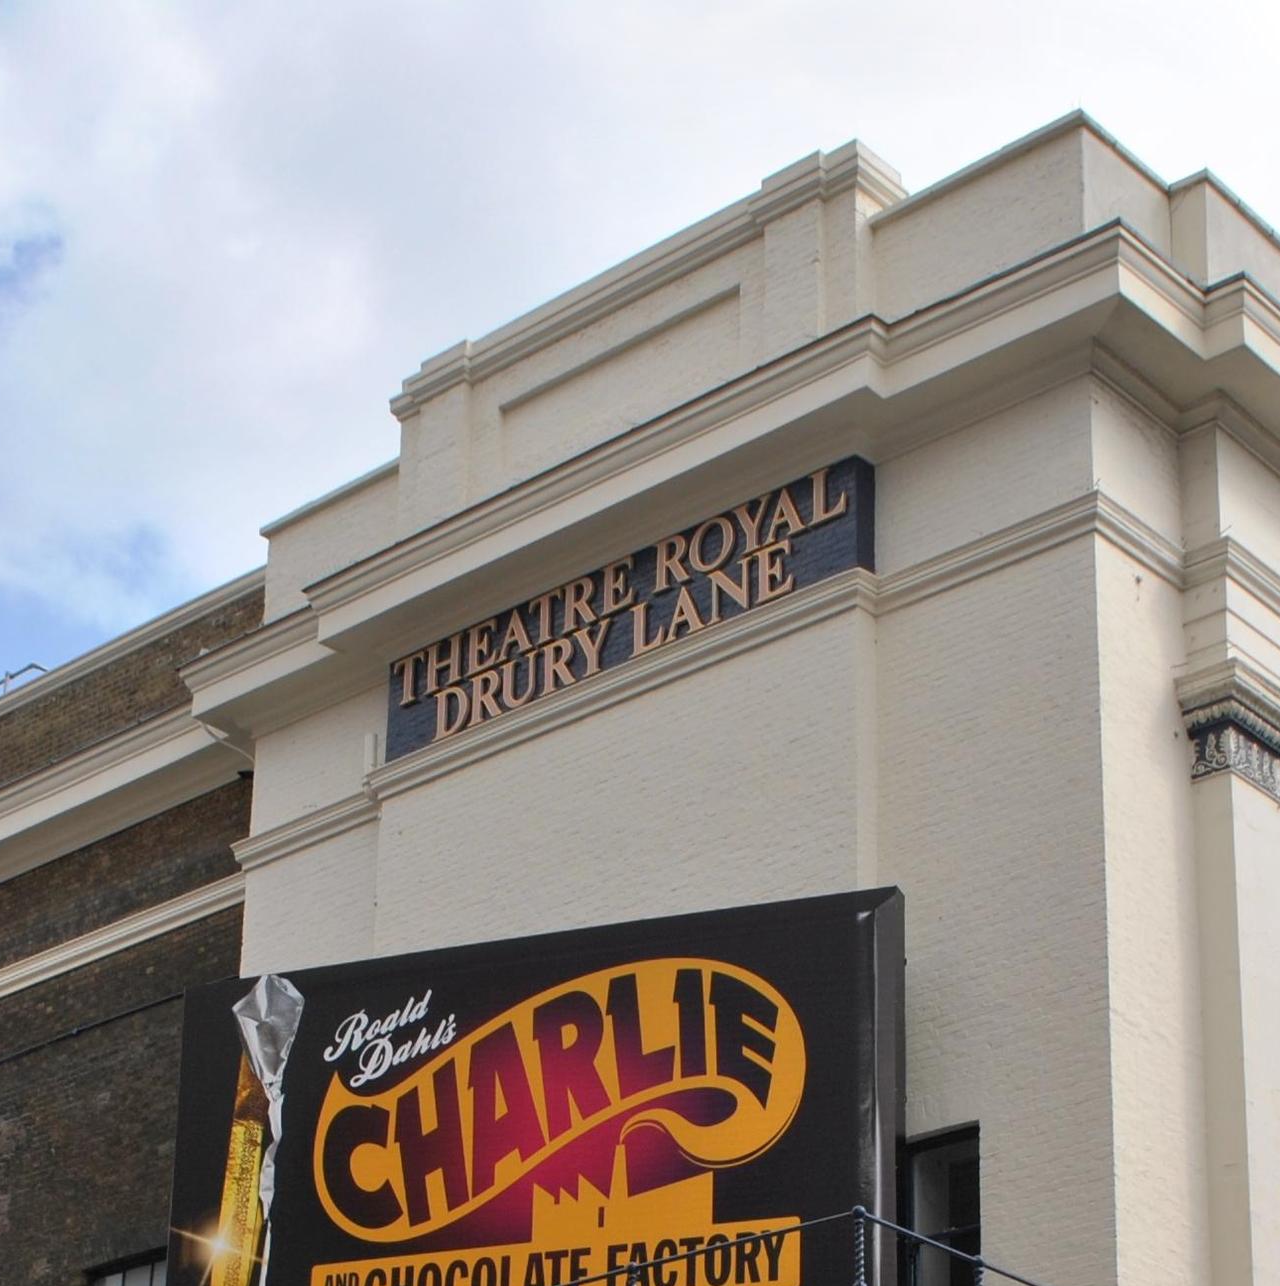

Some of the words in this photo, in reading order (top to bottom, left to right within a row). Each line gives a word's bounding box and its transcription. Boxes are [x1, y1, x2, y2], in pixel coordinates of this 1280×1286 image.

[393, 555, 635, 707] THEATRE
[654, 467, 848, 593] ROYAL
[432, 618, 610, 742] DRURY
[631, 539, 795, 659] LANE
[322, 967, 780, 1229] CHARLIE
[323, 988, 432, 1062] Roald
[350, 1013, 456, 1088] Dahl's
